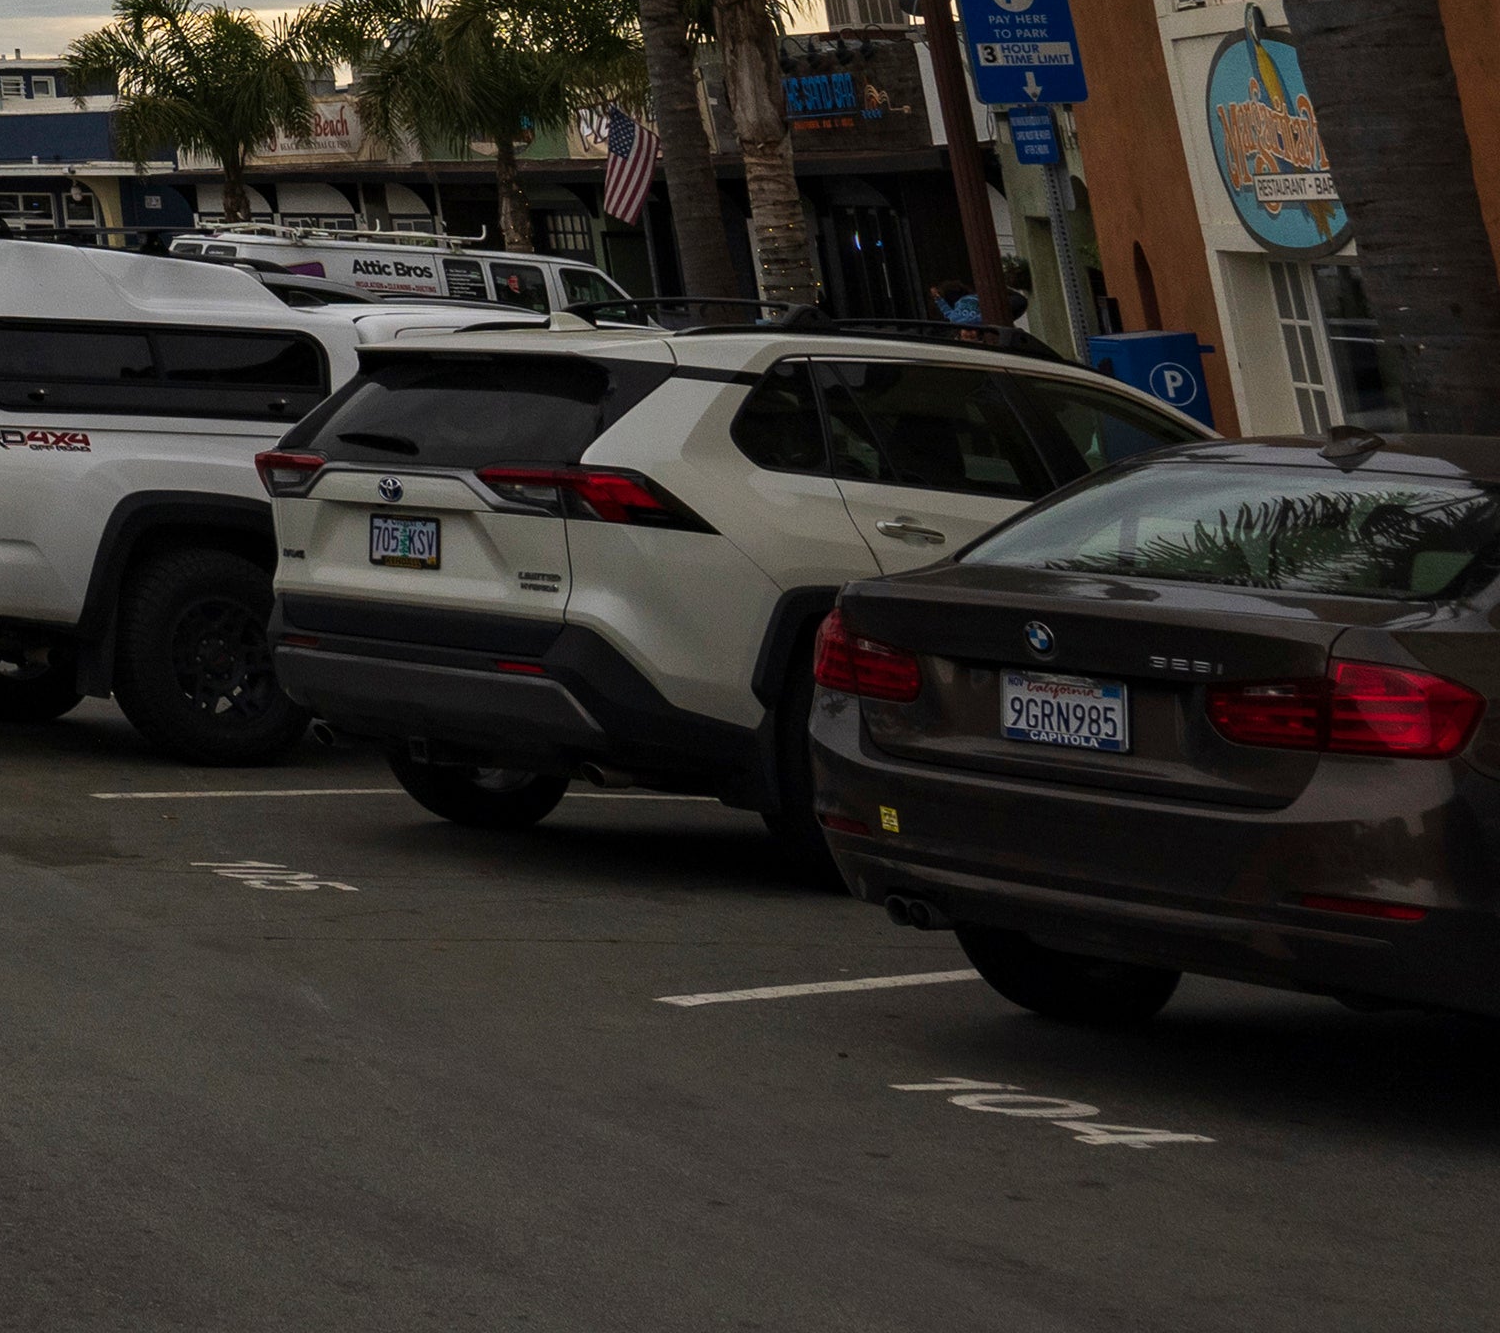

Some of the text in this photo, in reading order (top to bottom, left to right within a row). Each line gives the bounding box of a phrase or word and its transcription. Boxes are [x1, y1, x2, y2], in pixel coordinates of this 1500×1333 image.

[988, 14, 1049, 25] PAY HERE
[993, 28, 1050, 39] TO PARK
[983, 44, 1039, 64] 3 HOUR
[1003, 54, 1070, 64] TIME LIMIT
[314, 105, 350, 137] Beach
[1258, 179, 1308, 197] RESTAURANT
[1315, 178, 1336, 196] BAR
[352, 259, 434, 279] Attic Bros
[355, 281, 384, 290] INSULATION
[1163, 370, 1183, 398] P
[27, 430, 91, 446] 4X4
[29, 444, 55, 452] OFF
[373, 526, 400, 553] 705
[1027, 680, 1102, 700] California
[1010, 696, 1118, 738] 9GRN985
[1029, 729, 1100, 749] CAPITOLA
[887, 1076, 1218, 1150] 104
